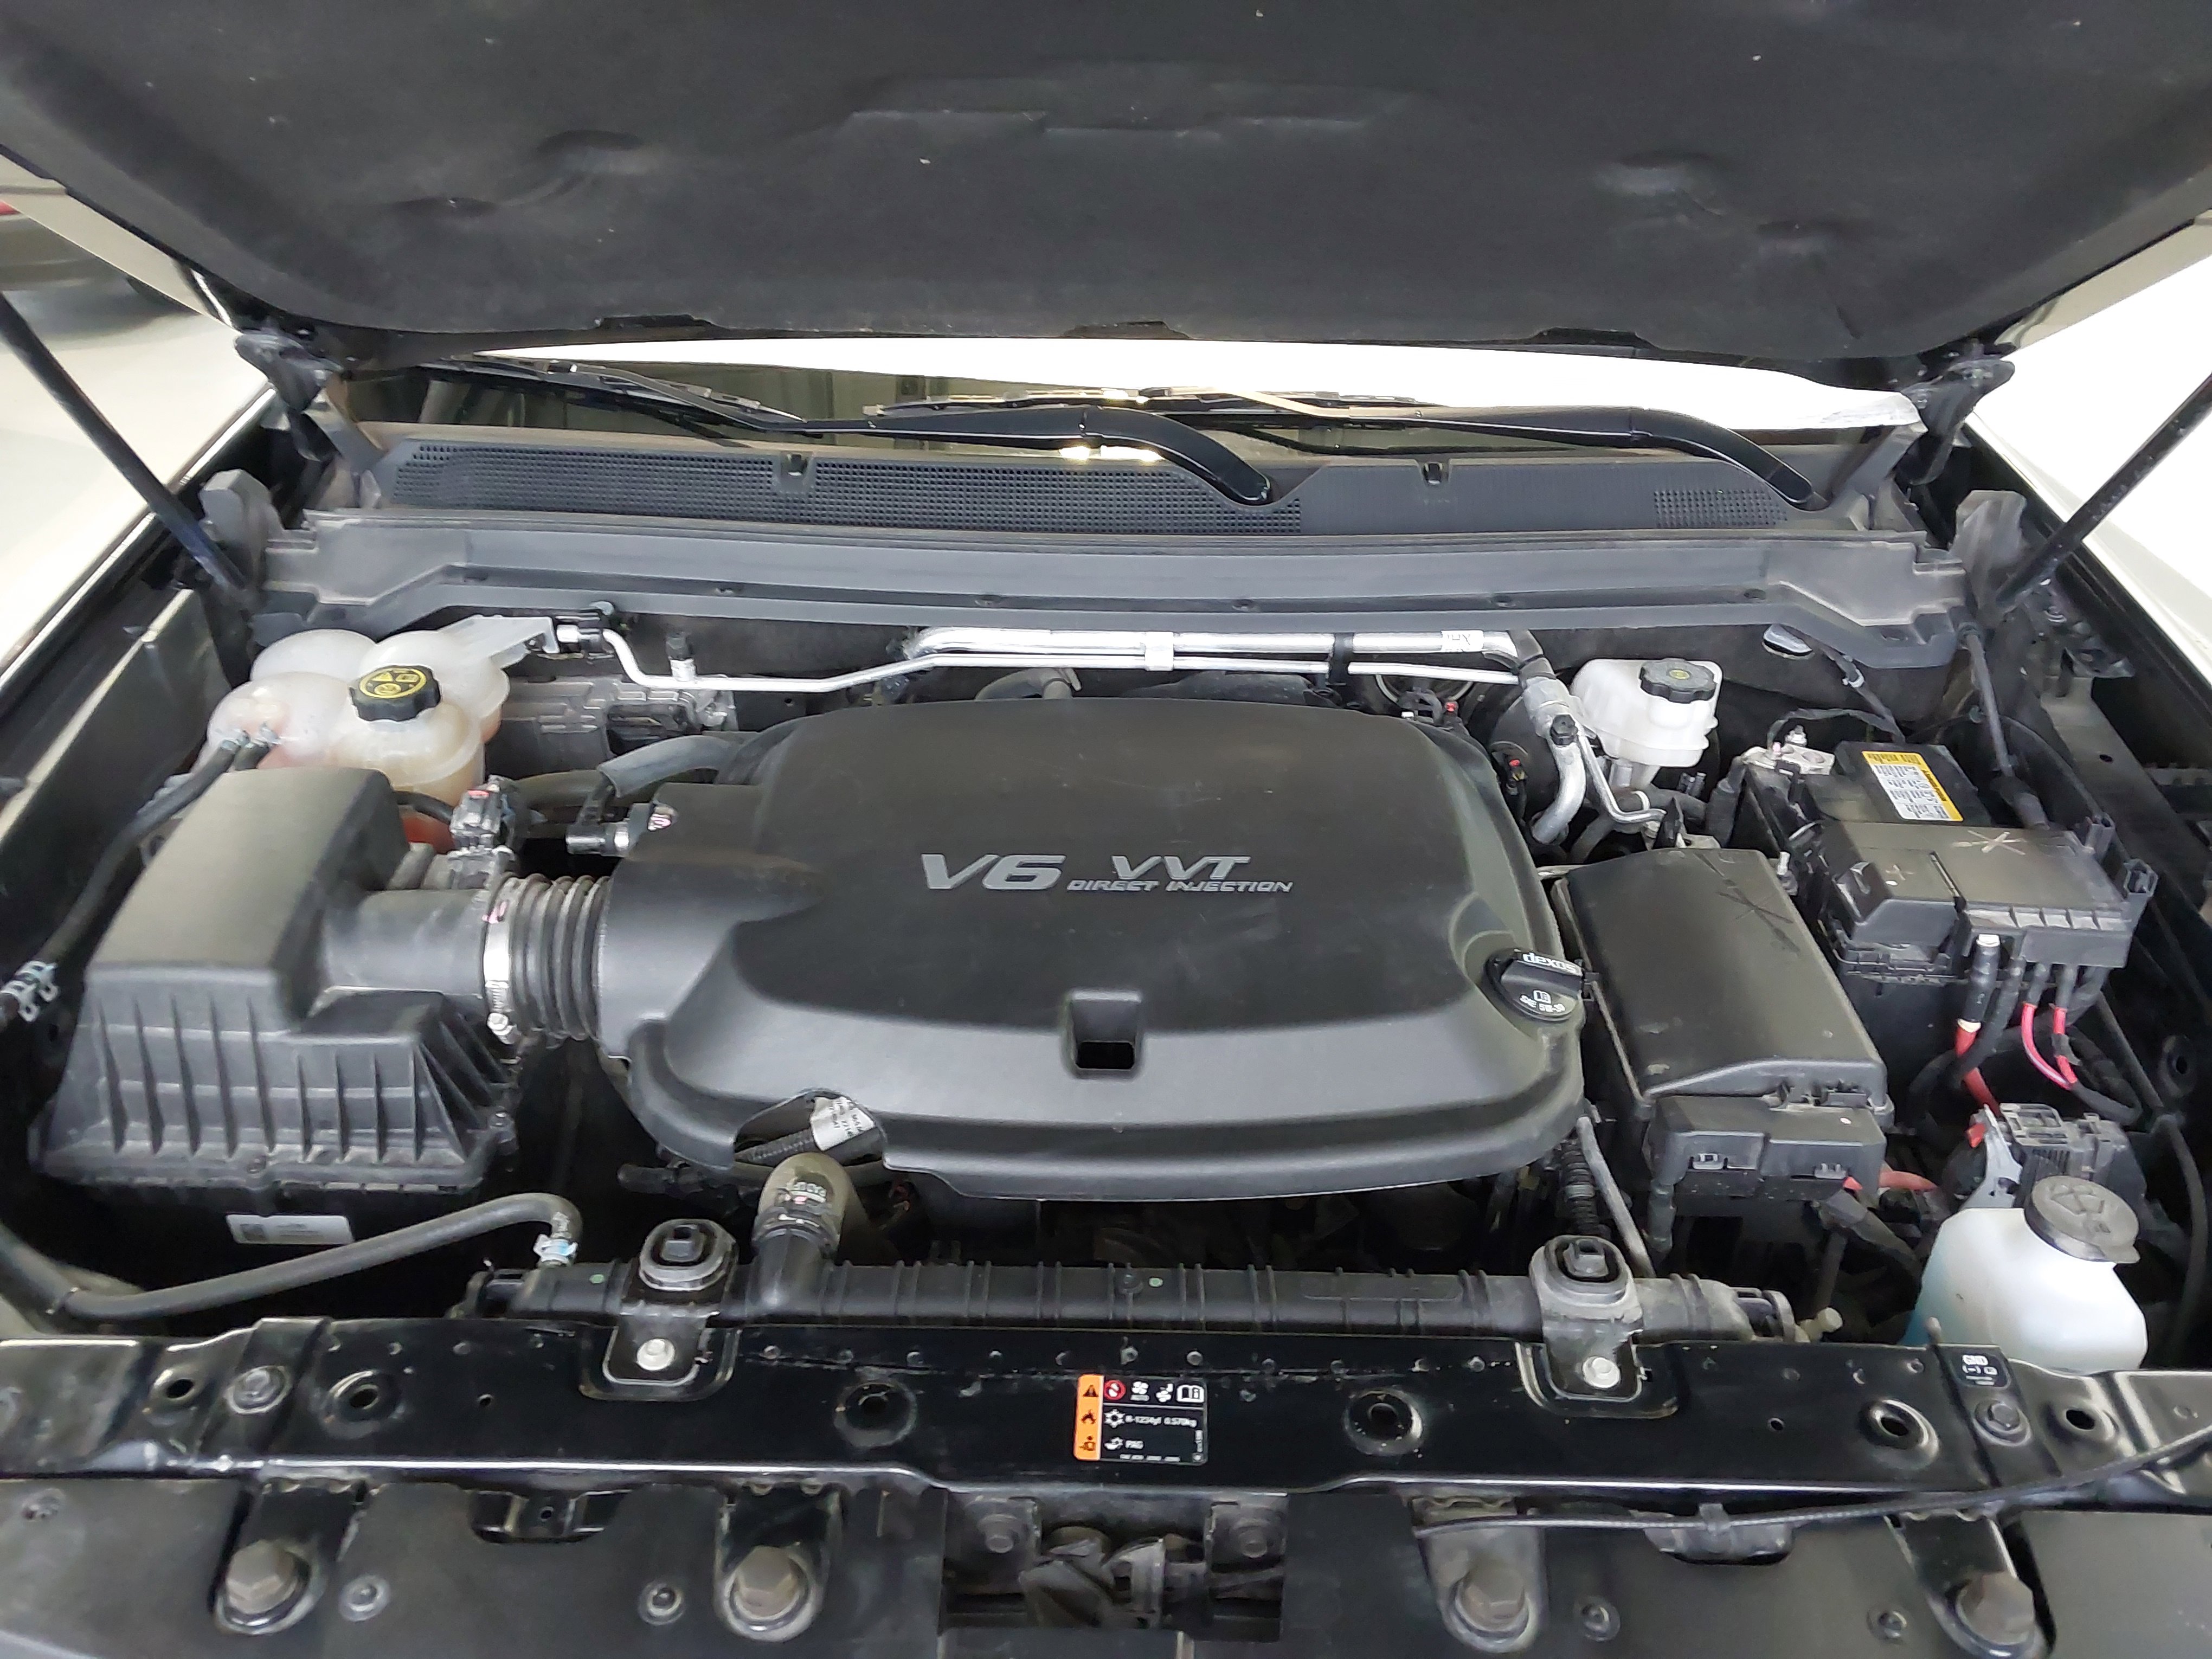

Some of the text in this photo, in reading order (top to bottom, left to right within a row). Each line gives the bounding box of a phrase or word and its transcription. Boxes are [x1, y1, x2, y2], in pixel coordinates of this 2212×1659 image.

[922, 854, 1251, 890] V6 VVT
[1067, 880, 1294, 892] DIRECT INJECTION
[1522, 952, 1577, 974] dexos
